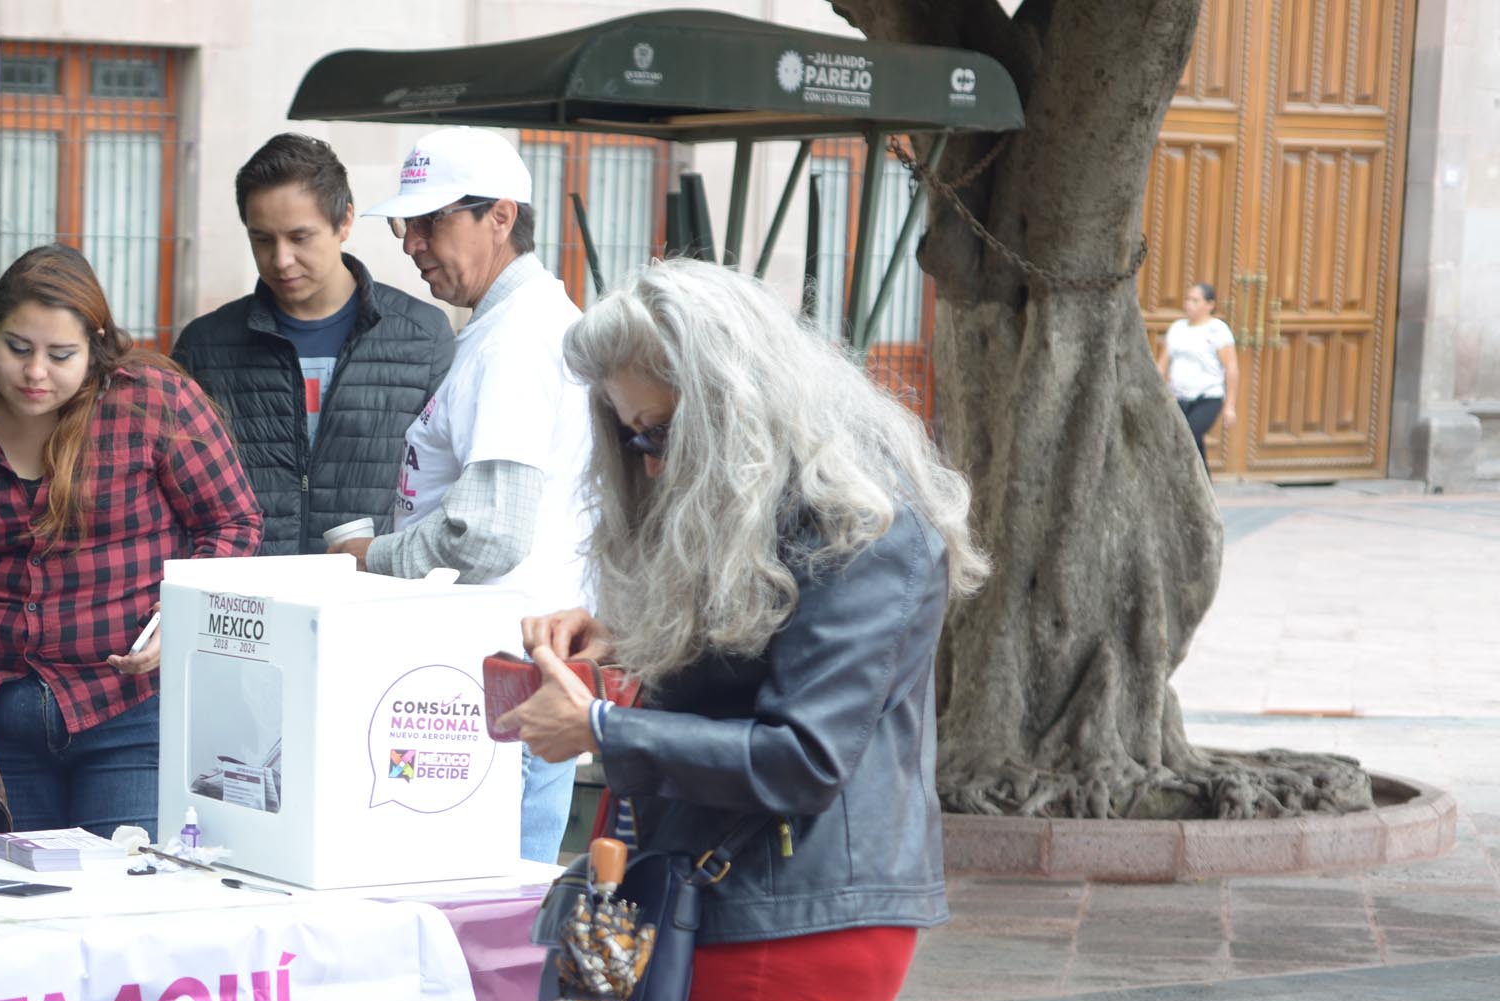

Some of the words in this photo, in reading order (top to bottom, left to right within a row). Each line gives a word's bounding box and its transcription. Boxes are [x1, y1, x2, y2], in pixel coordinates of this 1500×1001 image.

[814, 53, 867, 68] JALANDO
[805, 65, 872, 91] PAREJO
[208, 609, 264, 640] MÉXICO
[213, 638, 228, 649] 2018
[239, 641, 256, 654] 2024
[392, 700, 480, 716] CONSULTA
[391, 716, 479, 732] NACIONAL
[389, 731, 419, 739] NUEVO
[422, 732, 478, 741] AEROPUERTO
[417, 767, 468, 779] DECIDE
